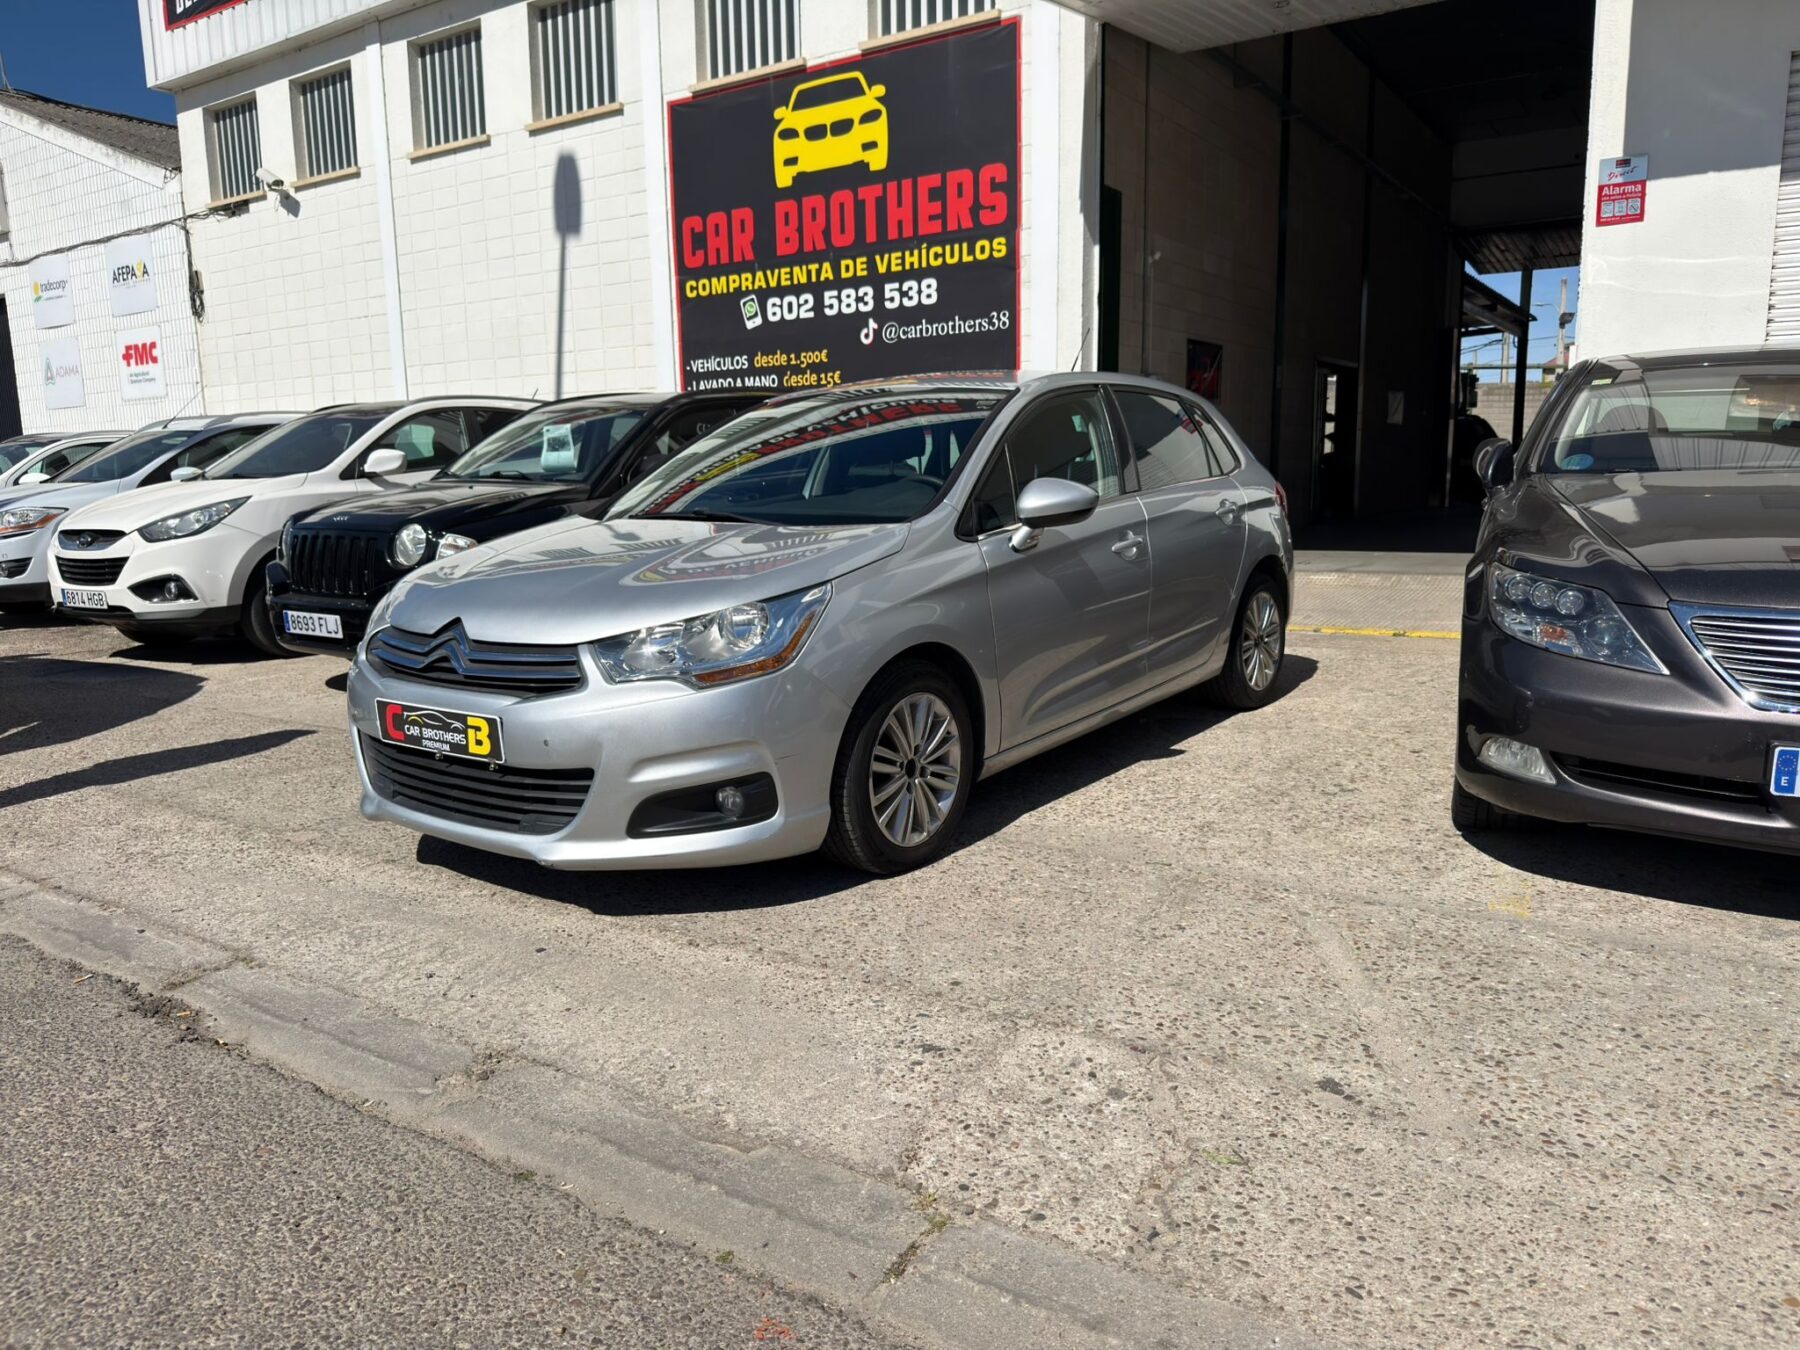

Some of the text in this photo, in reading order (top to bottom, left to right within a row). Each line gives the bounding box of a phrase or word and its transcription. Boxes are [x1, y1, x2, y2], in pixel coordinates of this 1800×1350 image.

[1602, 184, 1641, 196] Alarma
[682, 162, 1008, 269] CAR BROTHERS
[685, 237, 1007, 298] COMPRAVENTA DE VEHÍCULOS
[40, 280, 67, 293] tradecorp
[766, 278, 938, 322] 602 583 538
[882, 310, 1010, 343] @carbrothers38
[122, 341, 158, 367] FMC
[691, 349, 828, 373] VEHÍCULOS desde 1.500€
[56, 364, 80, 378] ADAMA
[745, 374, 778, 387] MANO
[783, 370, 817, 387] desde
[820, 370, 841, 388] 15€
[66, 591, 104, 607] 6814 HGB
[290, 614, 339, 635] 8693 FLJ
[386, 704, 405, 740] C
[404, 724, 466, 745] CAR BROTHERS
[422, 739, 450, 751] PREMIUM
[467, 716, 491, 755] B
[1781, 777, 1789, 786] E
